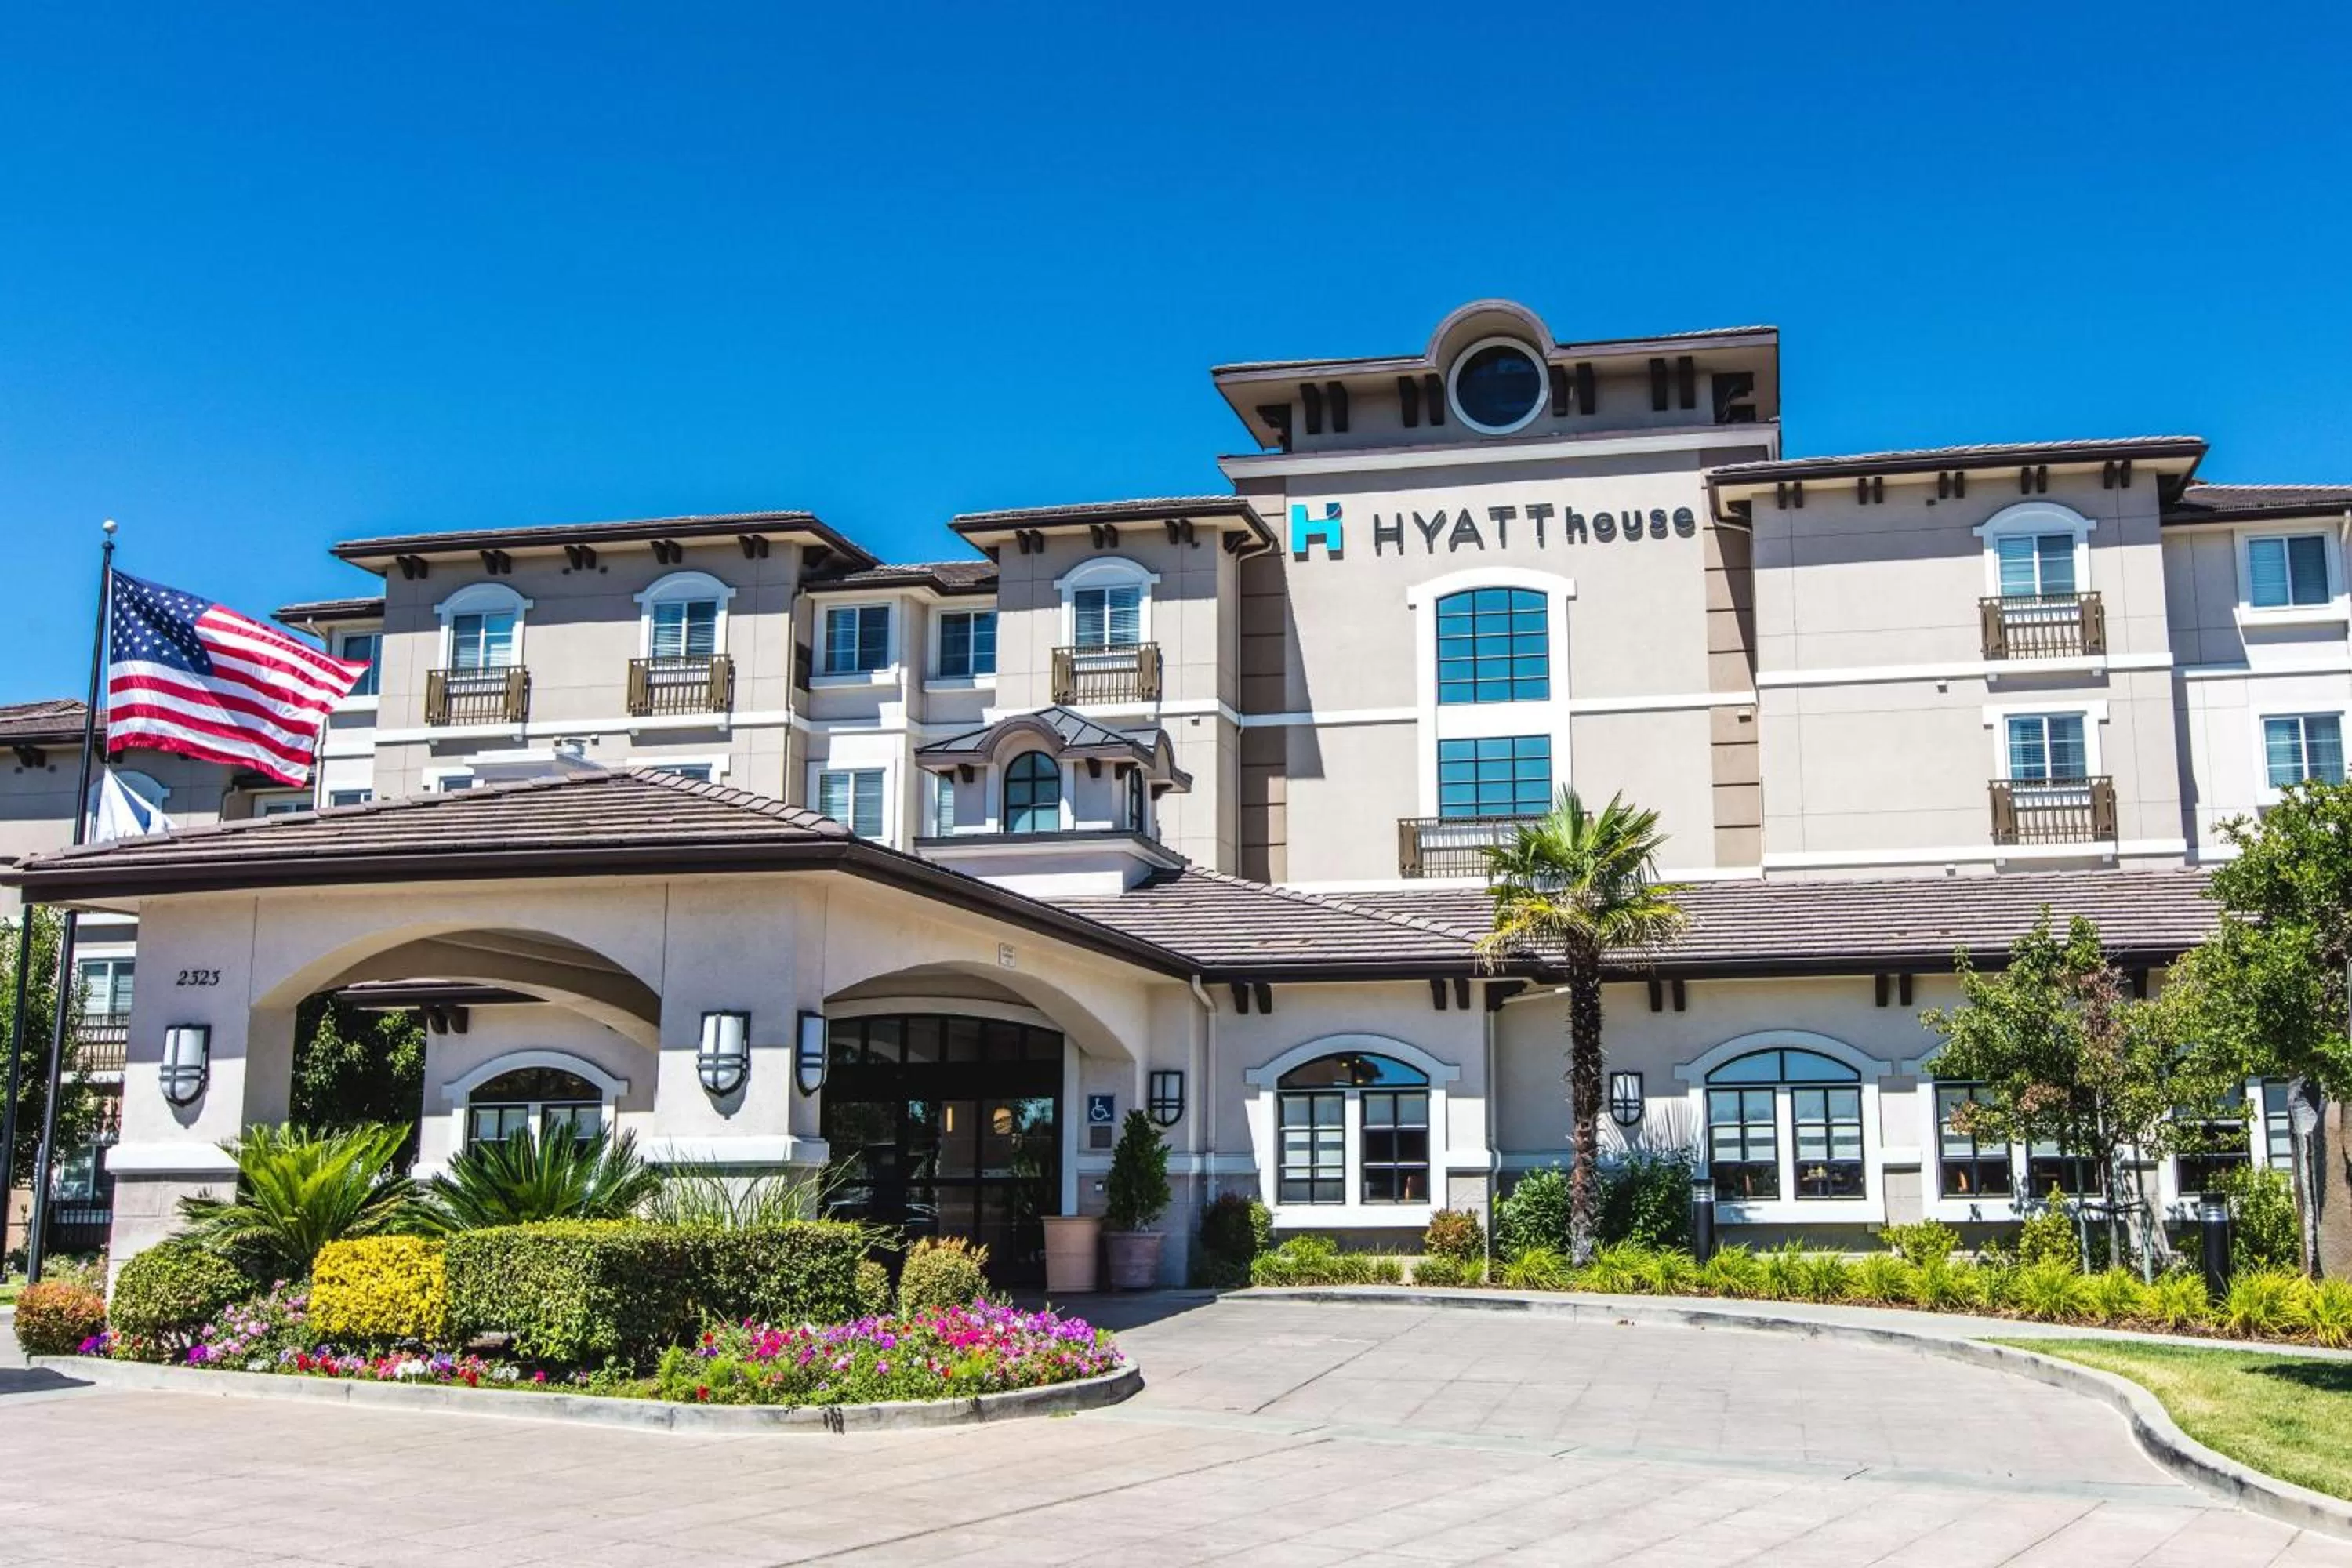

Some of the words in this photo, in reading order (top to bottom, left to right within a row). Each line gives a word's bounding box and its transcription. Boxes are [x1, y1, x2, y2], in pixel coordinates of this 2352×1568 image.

[1374, 503, 1554, 554] HYATT
[1566, 506, 1695, 543] house
[176, 969, 220, 985] 2323
